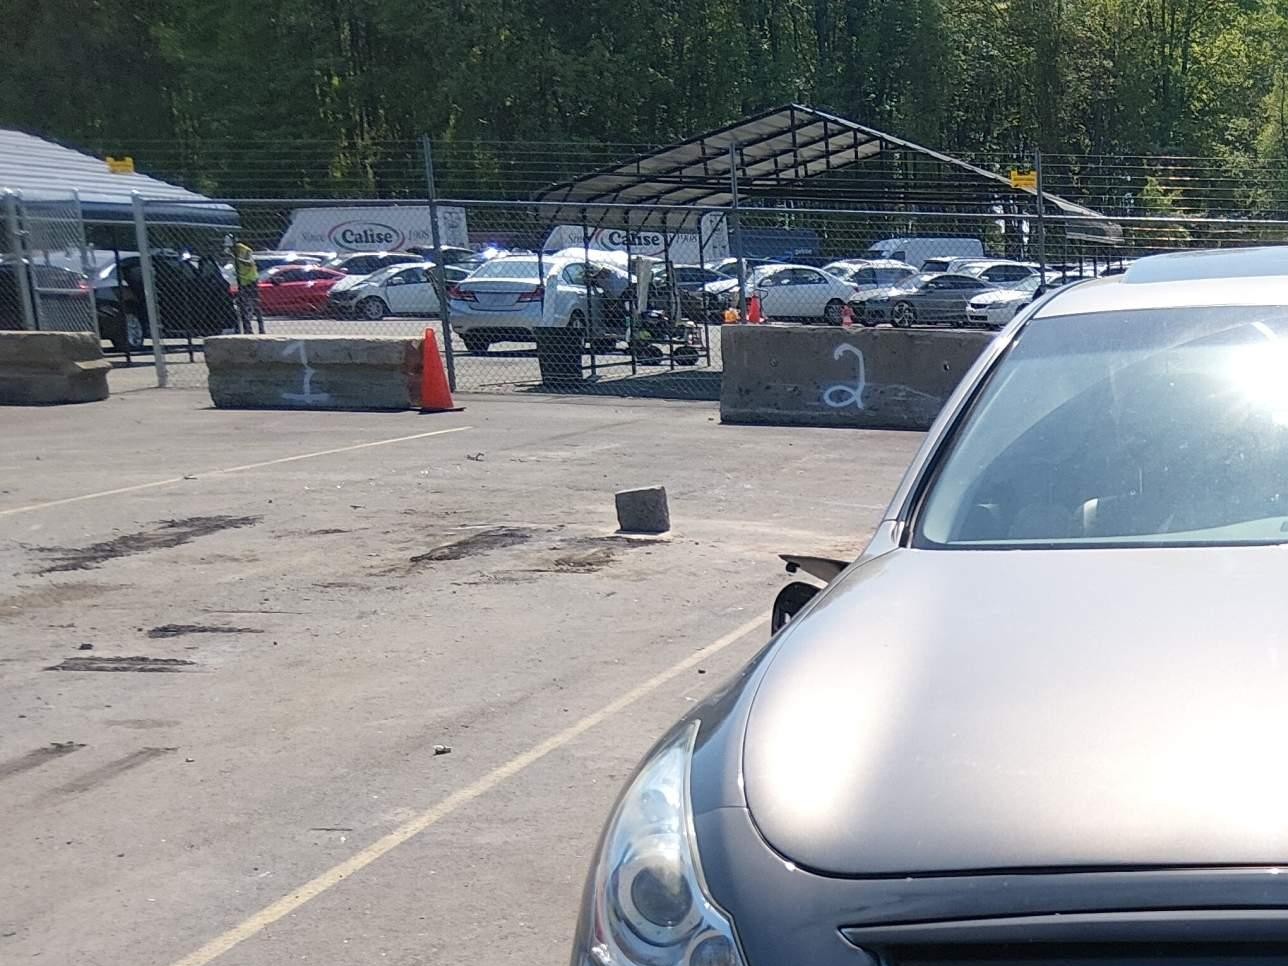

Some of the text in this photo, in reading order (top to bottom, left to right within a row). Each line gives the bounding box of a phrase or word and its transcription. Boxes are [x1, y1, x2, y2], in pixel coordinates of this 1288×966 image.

[341, 228, 393, 244] Calise
[608, 231, 660, 246] Calise
[823, 343, 865, 409] 2
